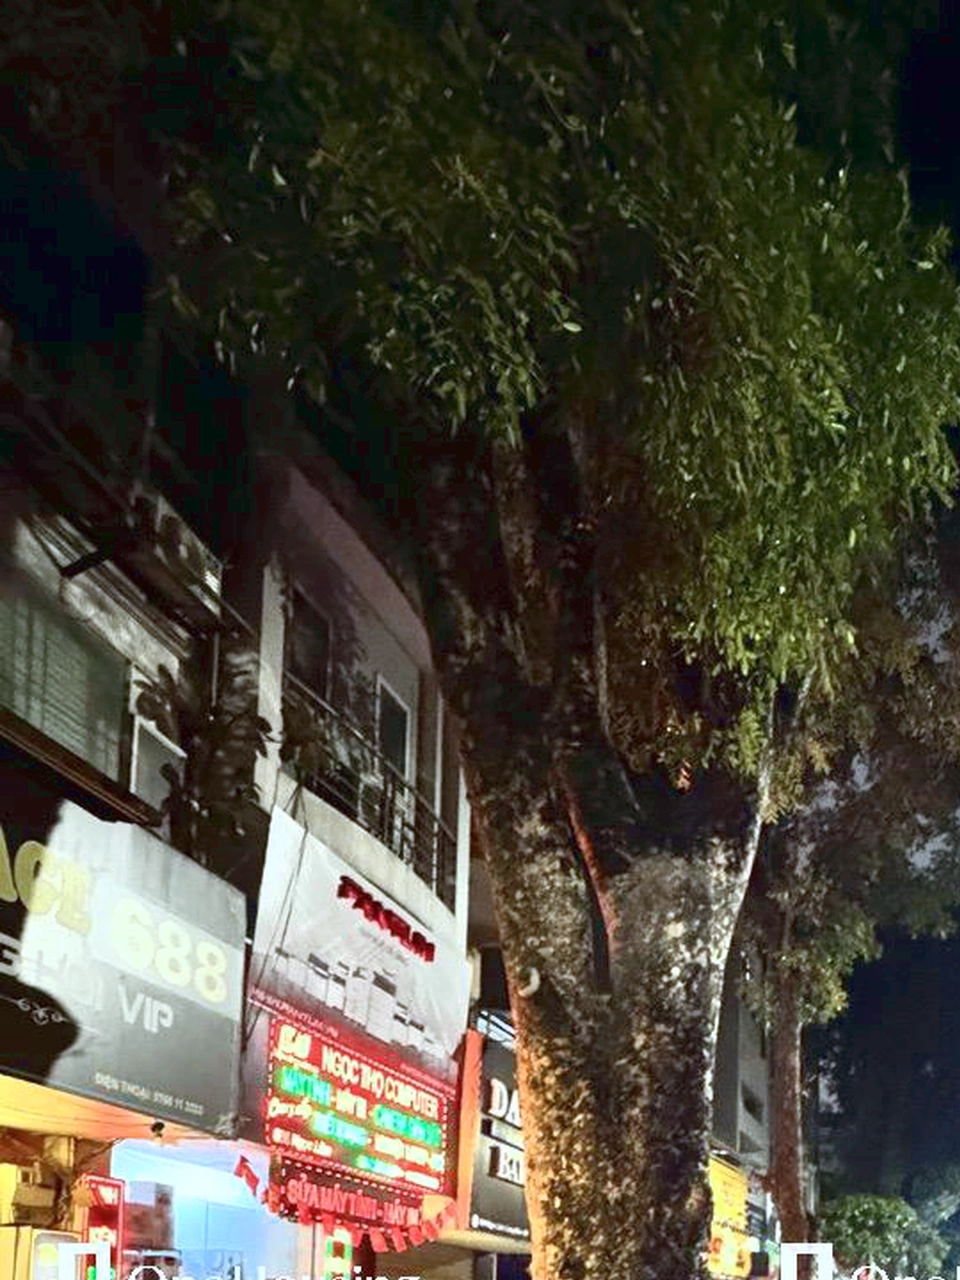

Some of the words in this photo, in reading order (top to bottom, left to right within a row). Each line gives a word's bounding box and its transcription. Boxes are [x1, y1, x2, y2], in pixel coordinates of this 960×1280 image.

[112, 897, 228, 1004] 688
[117, 983, 174, 1033] VIP
[384, 1076, 439, 1119] COMPUTER
